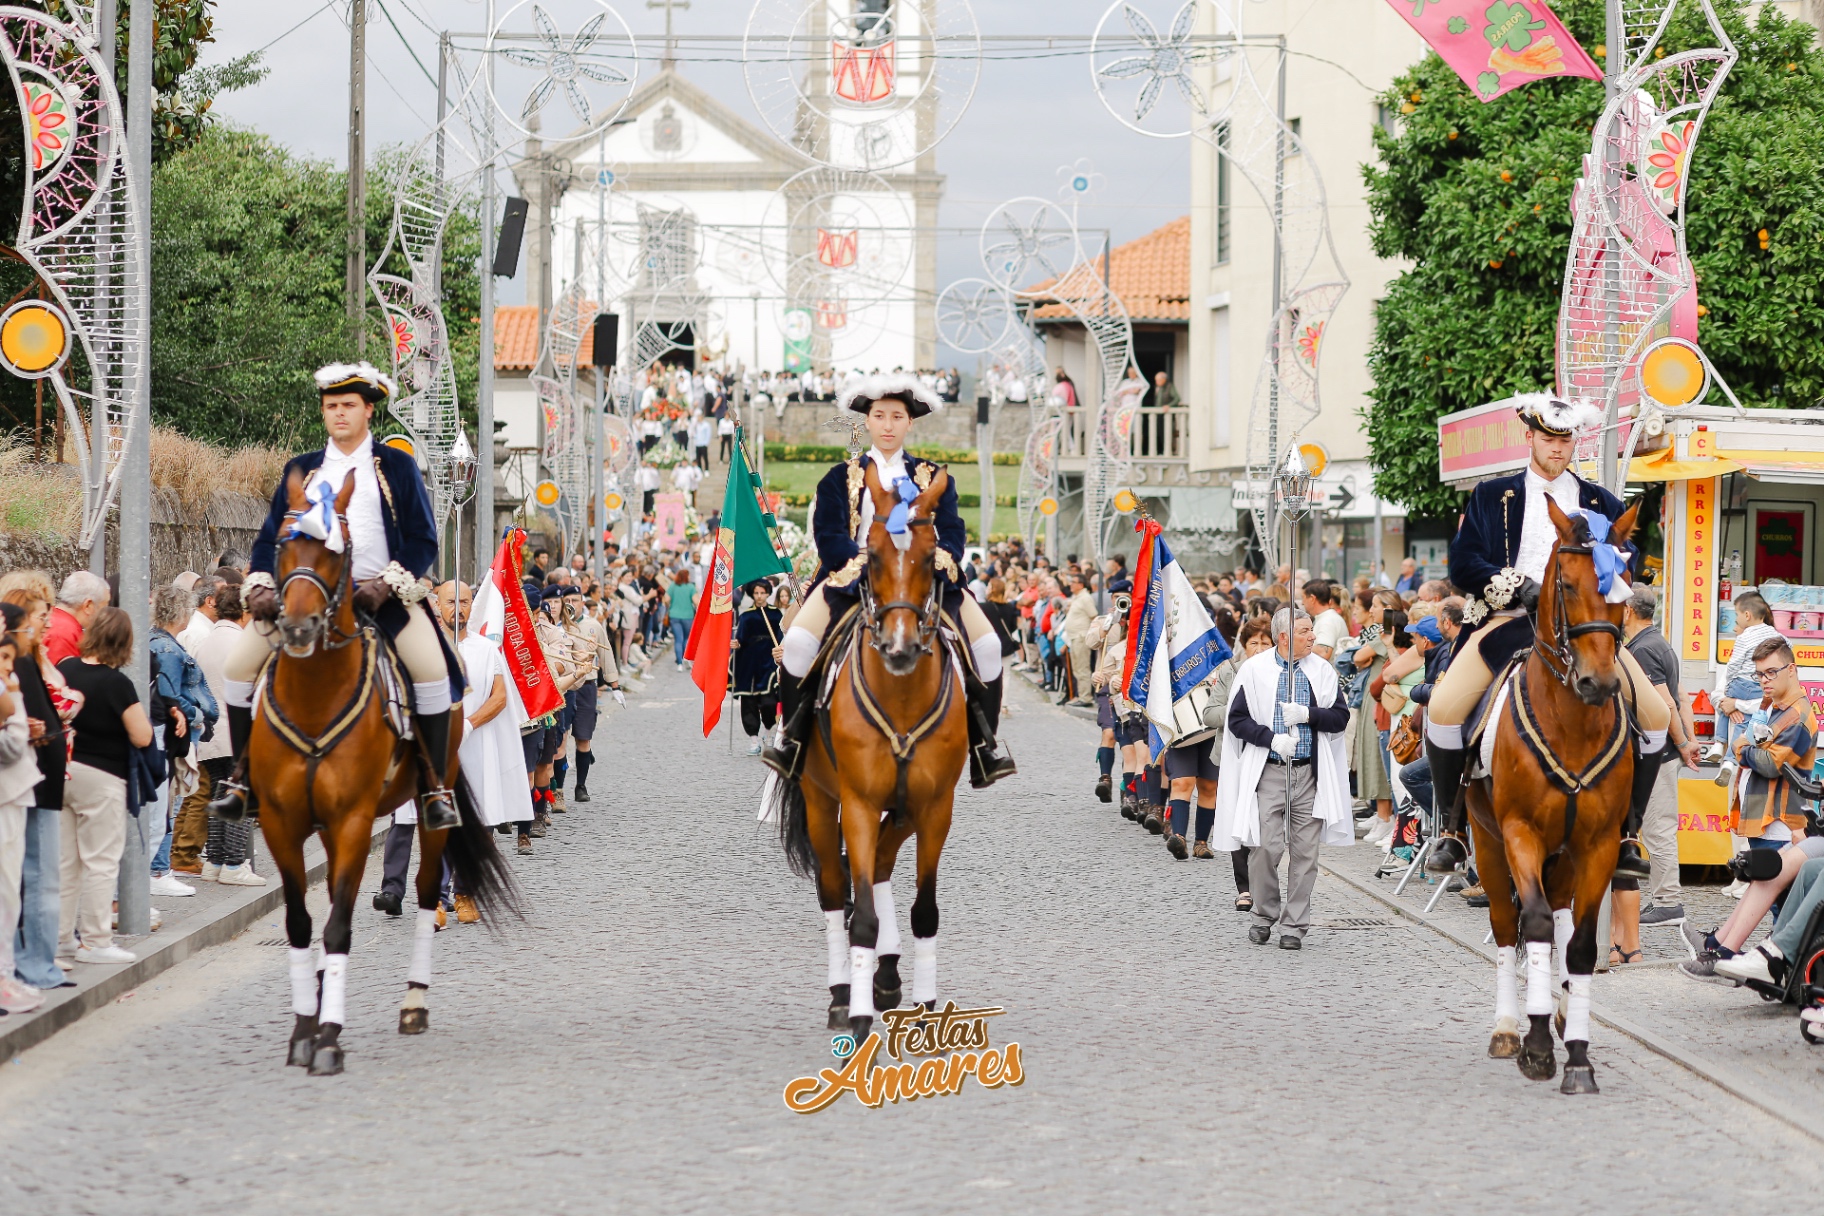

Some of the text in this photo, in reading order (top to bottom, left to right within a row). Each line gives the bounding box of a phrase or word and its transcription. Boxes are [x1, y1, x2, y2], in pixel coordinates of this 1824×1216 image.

[1691, 438, 1707, 652] CRROS PORRAS
[1171, 653, 1203, 684] ERREIROS
